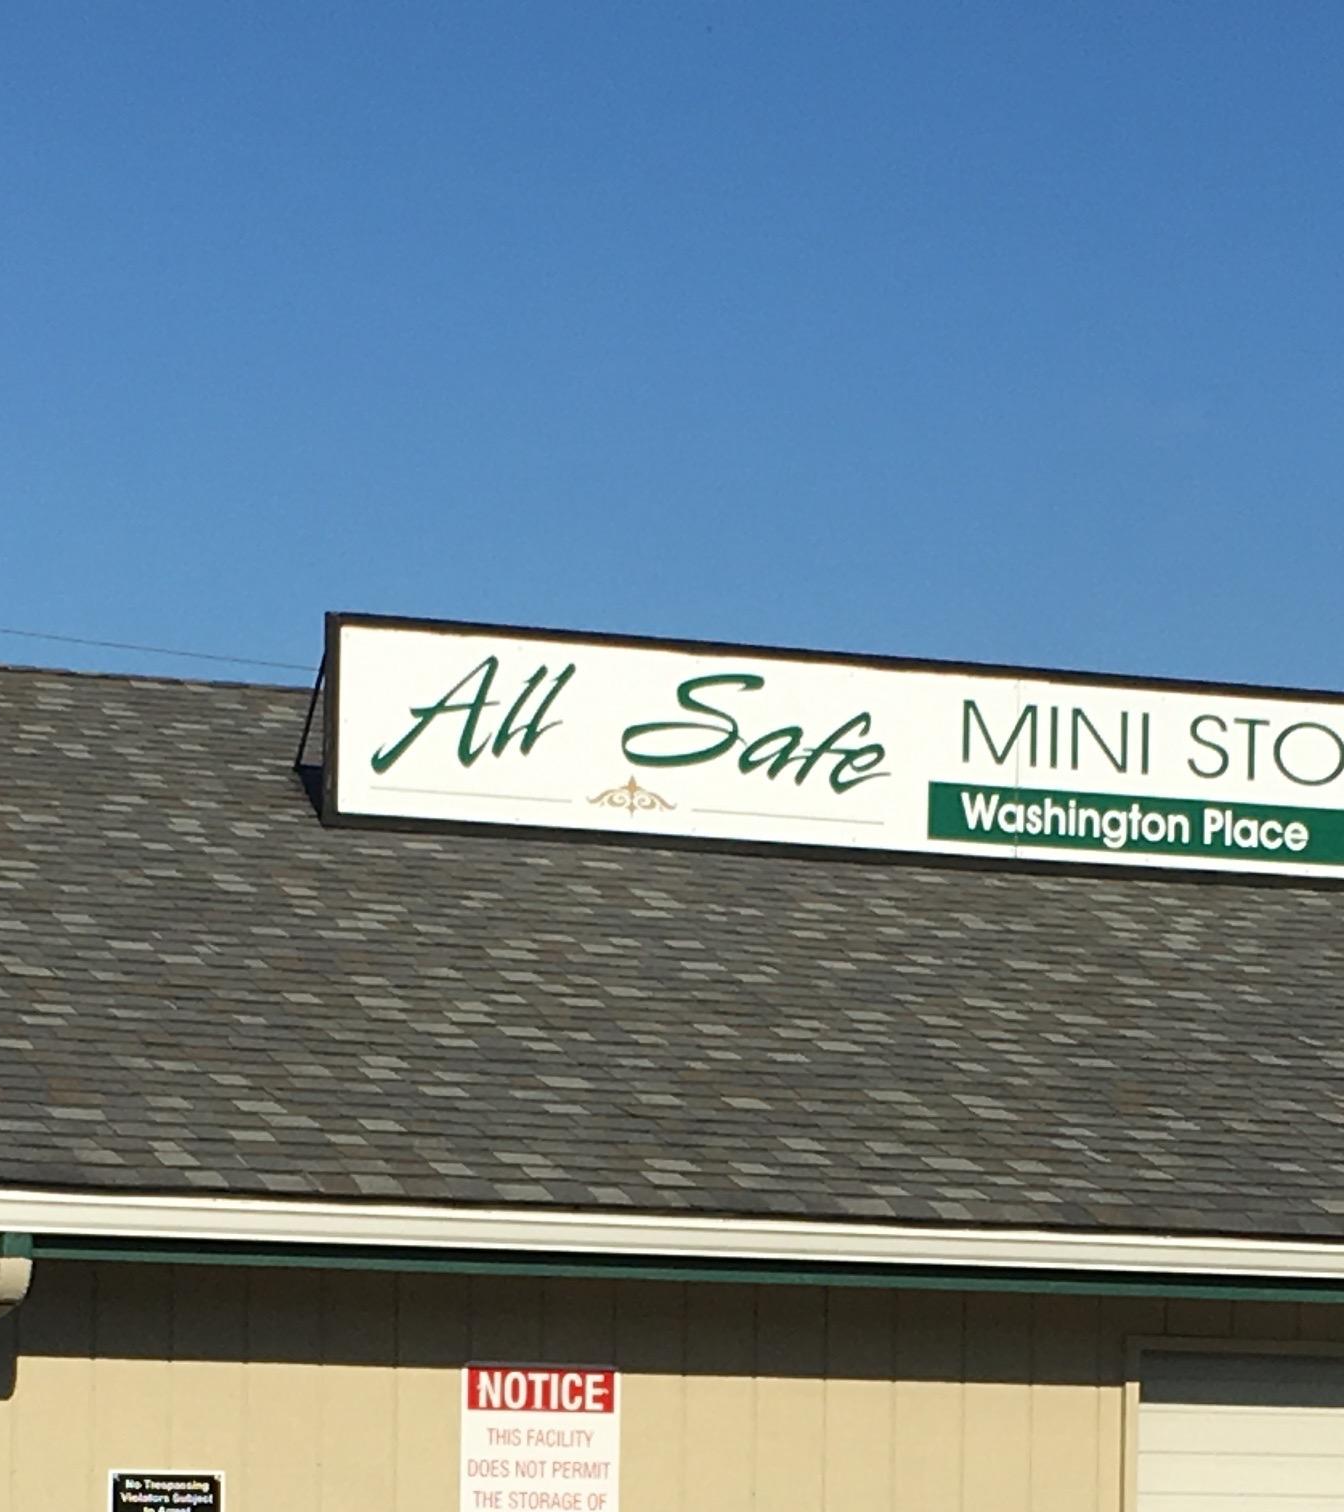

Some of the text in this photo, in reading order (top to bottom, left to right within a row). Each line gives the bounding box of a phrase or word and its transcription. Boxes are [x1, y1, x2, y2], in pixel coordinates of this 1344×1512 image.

[371, 654, 891, 795] All Safe
[960, 699, 1150, 775] MINI
[960, 791, 1191, 849] Washington
[1202, 807, 1310, 852] Place
[477, 1371, 609, 1411] NOTICE
[487, 1427, 594, 1447] THIS FACILITY
[125, 1479, 142, 1489] No
[467, 1459, 611, 1480] DOES NOT PERMIT
[473, 1490, 607, 1511] THE STORAGE OF
